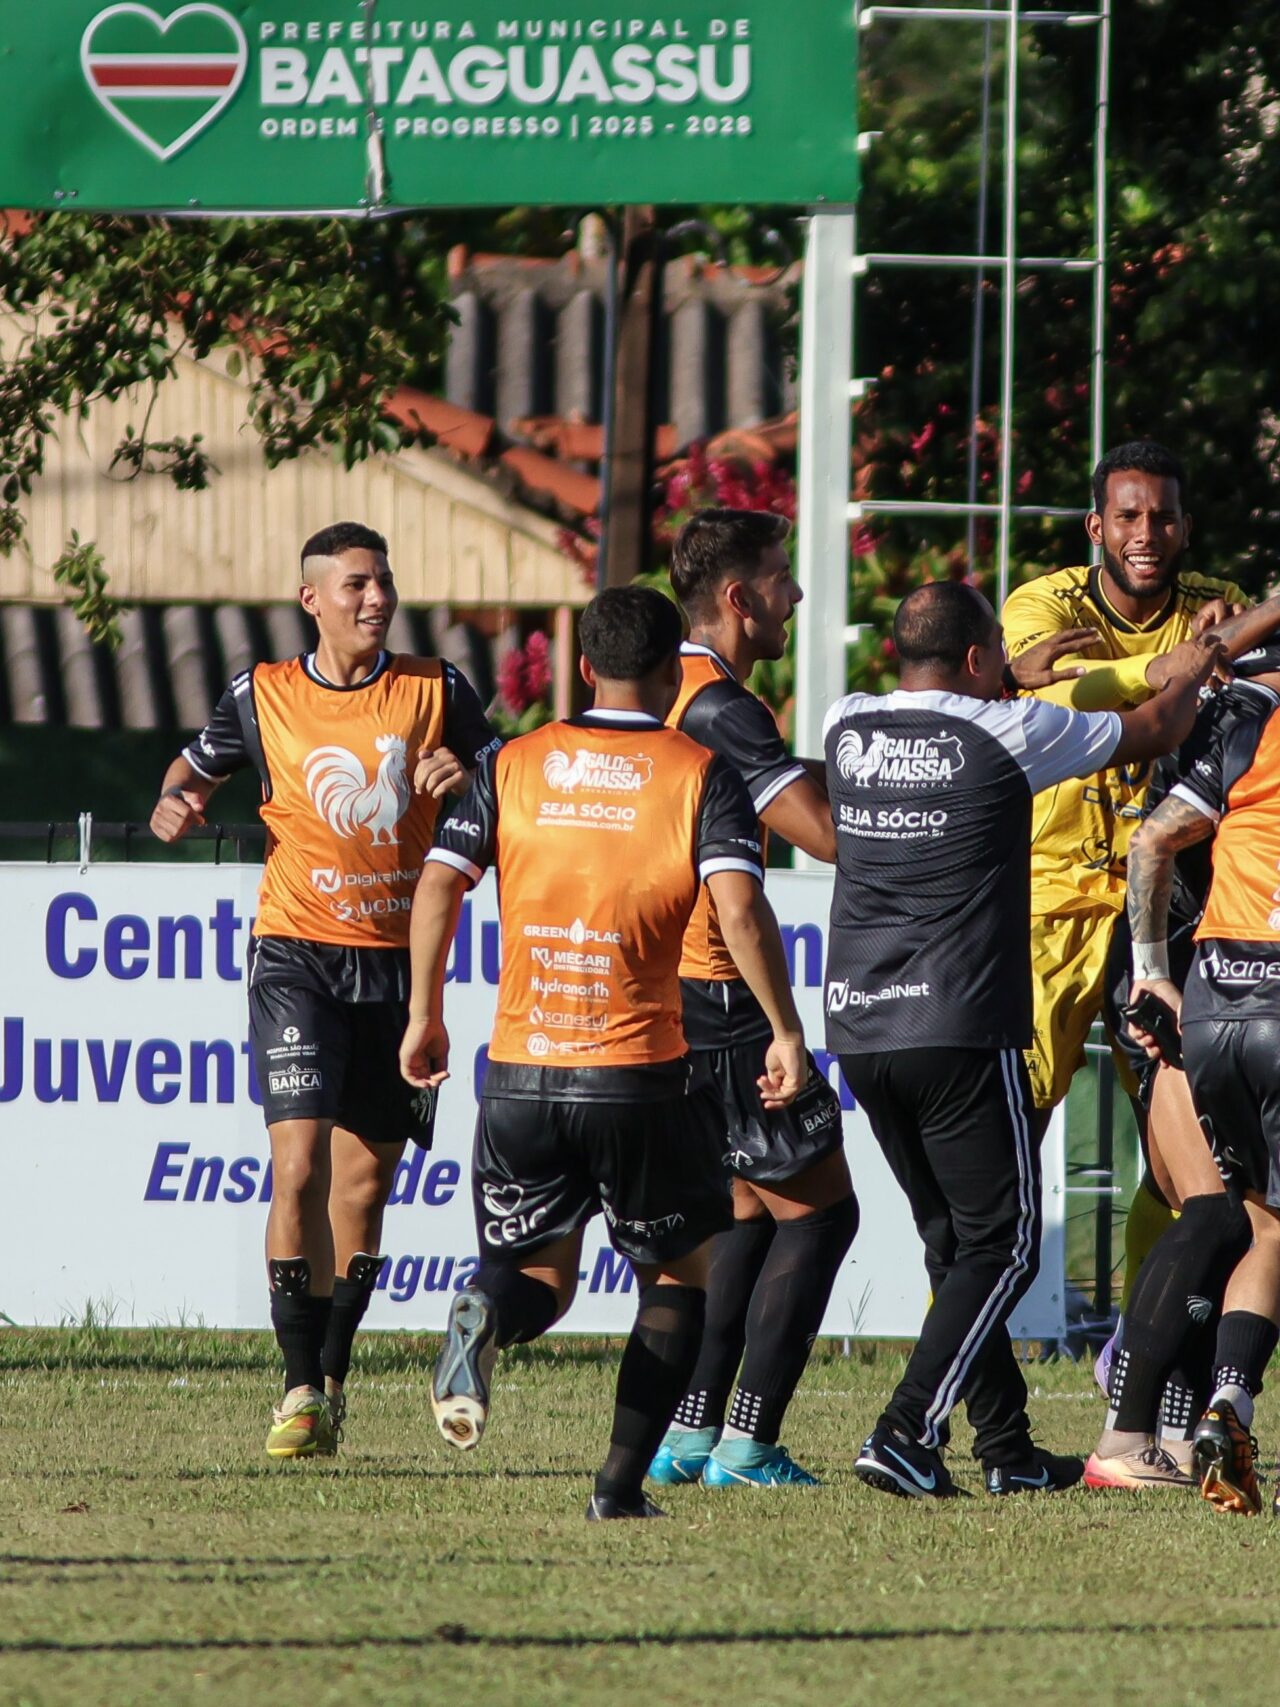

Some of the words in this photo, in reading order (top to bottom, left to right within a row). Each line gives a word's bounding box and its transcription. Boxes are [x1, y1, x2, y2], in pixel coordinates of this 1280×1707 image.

[260, 20, 477, 41] PREFEITURA
[497, 18, 690, 38] MUNICIPAL
[709, 18, 750, 37] DE
[259, 43, 751, 105] BATAGUASSU
[261, 117, 358, 136] ORDEM
[395, 116, 561, 136] PROGRESSO
[589, 115, 653, 135] 2025
[686, 115, 752, 135] 2028
[885, 737, 927, 759] GALO
[925, 747, 939, 758] DA
[585, 752, 626, 771] GALO
[878, 757, 953, 781] MASSA
[581, 768, 642, 791] MASSA
[539, 801, 577, 817] SEJA
[579, 801, 637, 822] SÓCIO
[840, 804, 873, 827] SEJA
[876, 808, 948, 828] SÓCIO
[345, 869, 420, 886] DigitalNet
[360, 897, 411, 915] UCDB
[45, 891, 256, 981] Cent
[523, 924, 569, 939] GREEN
[585, 929, 622, 943] PLAC
[553, 949, 611, 968] MÉCARI
[530, 975, 610, 999] Hydronorth
[848, 981, 930, 1009] DigalNet
[544, 1011, 609, 1029] sanesul
[0, 1017, 266, 1106] Juvent
[271, 1073, 321, 1092] BANCA
